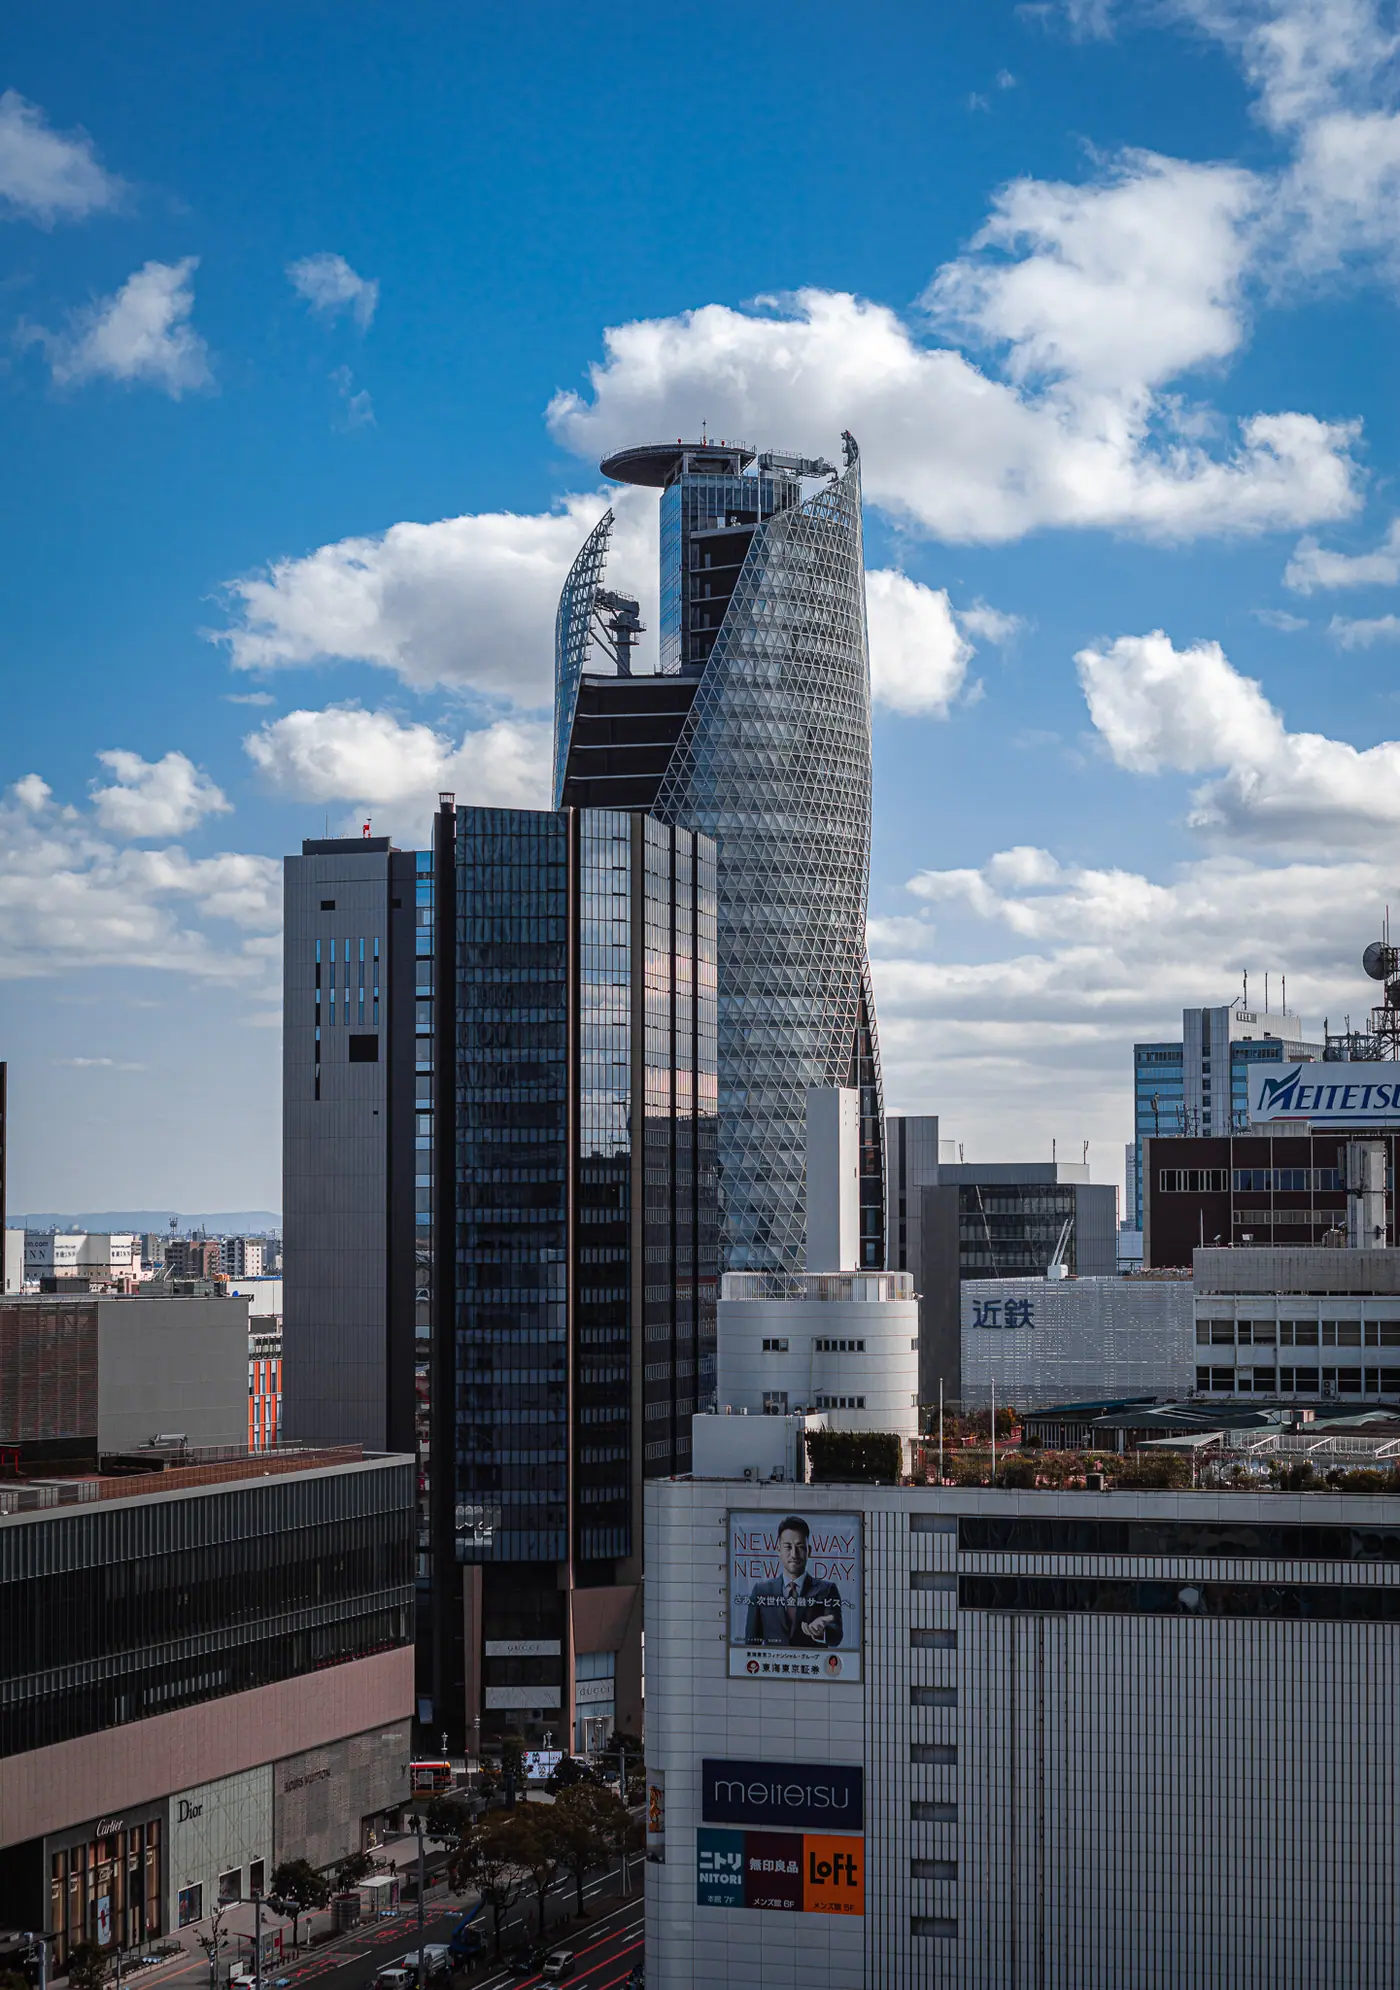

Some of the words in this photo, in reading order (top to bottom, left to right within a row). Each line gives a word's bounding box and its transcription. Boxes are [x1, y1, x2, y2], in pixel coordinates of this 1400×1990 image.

[972, 1298, 1034, 1329] 近鉄
[734, 1533, 779, 1552] NEW
[734, 1560, 780, 1579] NEW
[814, 1562, 855, 1582] DAY.
[762, 1662, 821, 1675] 東海東京証券
[580, 1686, 610, 1696] GUCCI
[177, 1799, 203, 1823] Dior
[96, 1819, 124, 1837] Cartier
[699, 1851, 742, 1871] ニトリ
[749, 1857, 799, 1874] 無印良品
[699, 1873, 742, 1885] NITORI
[724, 1896, 735, 1905] 7F
[753, 1897, 782, 1908] メンズ館
[783, 1899, 795, 1908] 6F
